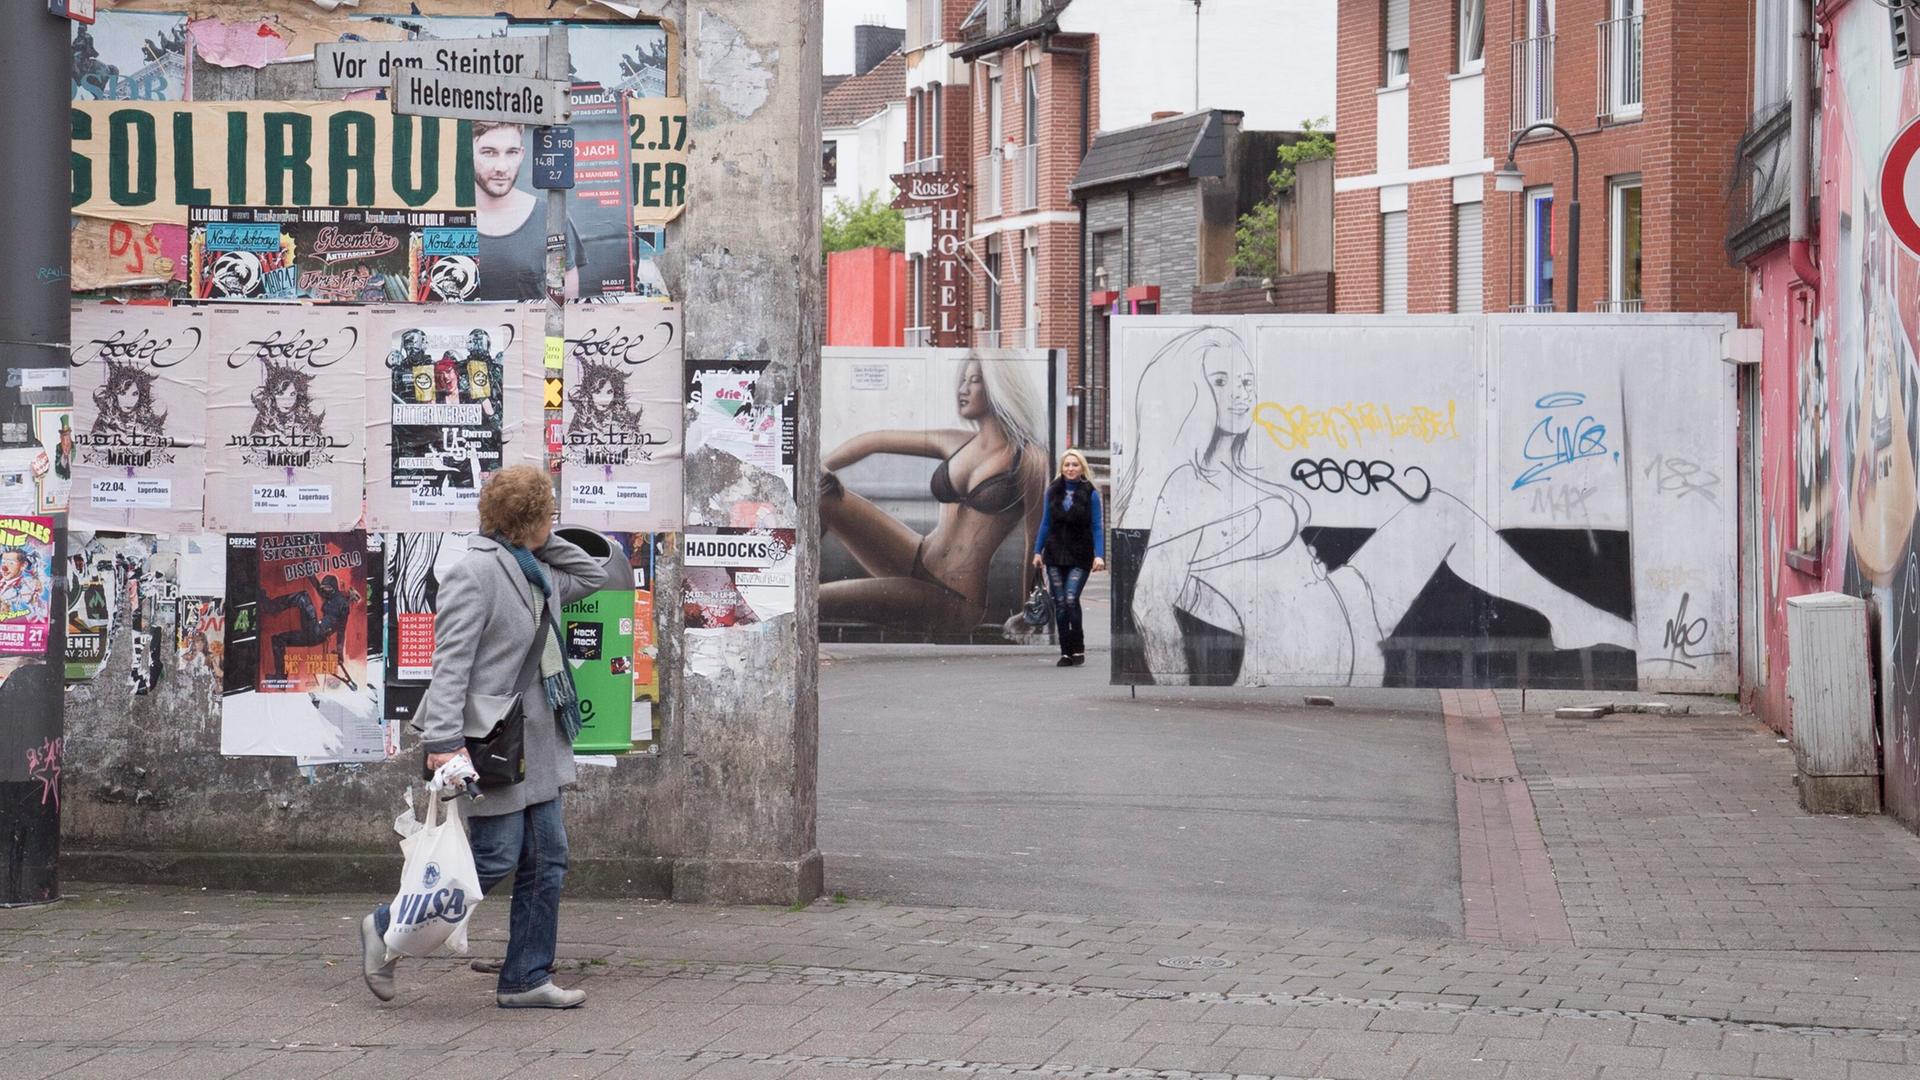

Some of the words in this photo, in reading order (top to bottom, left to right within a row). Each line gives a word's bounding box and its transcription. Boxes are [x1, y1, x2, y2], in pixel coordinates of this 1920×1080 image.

[332, 52, 367, 79] Vor
[378, 51, 424, 78] dem
[436, 47, 525, 78] Steintor
[411, 76, 544, 116] Helenenstraße
[571, 94, 617, 106] DLMDLA
[542, 135, 553, 149] S
[557, 139, 574, 149] 150
[583, 145, 616, 157] JACH
[534, 157, 551, 167] 14.8
[549, 170, 562, 180] 2.7
[314, 225, 399, 252] Gloomster
[937, 208, 959, 333] HOTEL
[461, 429, 492, 438] UNITED
[464, 441, 482, 449] AND
[107, 448, 152, 467] MAKEUP
[267, 449, 311, 467] MAKEUP
[585, 447, 629, 465] MAKEUP
[99, 481, 127, 492] 22.04.
[137, 486, 169, 494] Lagerhaus
[261, 488, 288, 498] 22.04.
[579, 485, 606, 496] 22.04.
[298, 493, 330, 501] Lagerhaus
[616, 491, 648, 499] Lagerhaus
[261, 532, 321, 550] ALARM
[263, 544, 331, 561] SIGNAL
[686, 541, 767, 559] HADDOCKS
[284, 560, 321, 582] DISCO
[332, 550, 362, 570] OSLO
[562, 600, 600, 614] anke!
[66, 637, 100, 649] EMEN
[78, 649, 100, 657] 2017
[396, 887, 468, 925] VILSA
